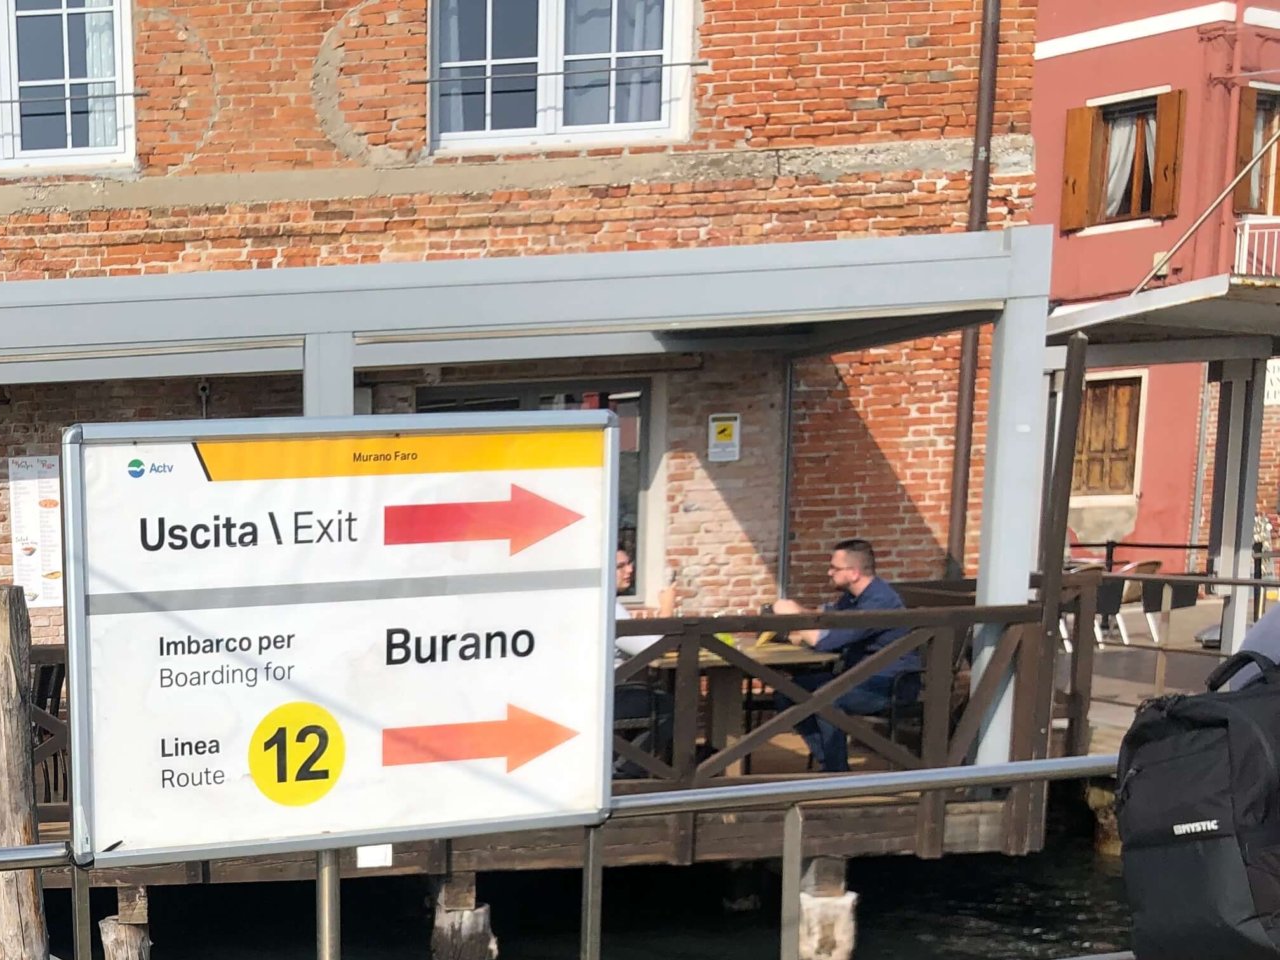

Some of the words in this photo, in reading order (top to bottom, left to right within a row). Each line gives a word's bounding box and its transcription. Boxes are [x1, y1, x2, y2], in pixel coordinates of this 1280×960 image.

[352, 452, 392, 463] Murano
[394, 450, 418, 462] Faro
[149, 462, 174, 474] Actv
[139, 515, 259, 552] Uscita
[293, 510, 358, 545] Exit
[159, 635, 252, 656] Imbarco
[258, 633, 296, 656] per
[386, 627, 535, 666] Burano
[159, 664, 258, 688] Boarding
[263, 661, 295, 682] for
[160, 737, 220, 758] Linea
[263, 724, 329, 783] 12
[161, 767, 226, 788] Route
[1179, 819, 1219, 835] MYSTIC
